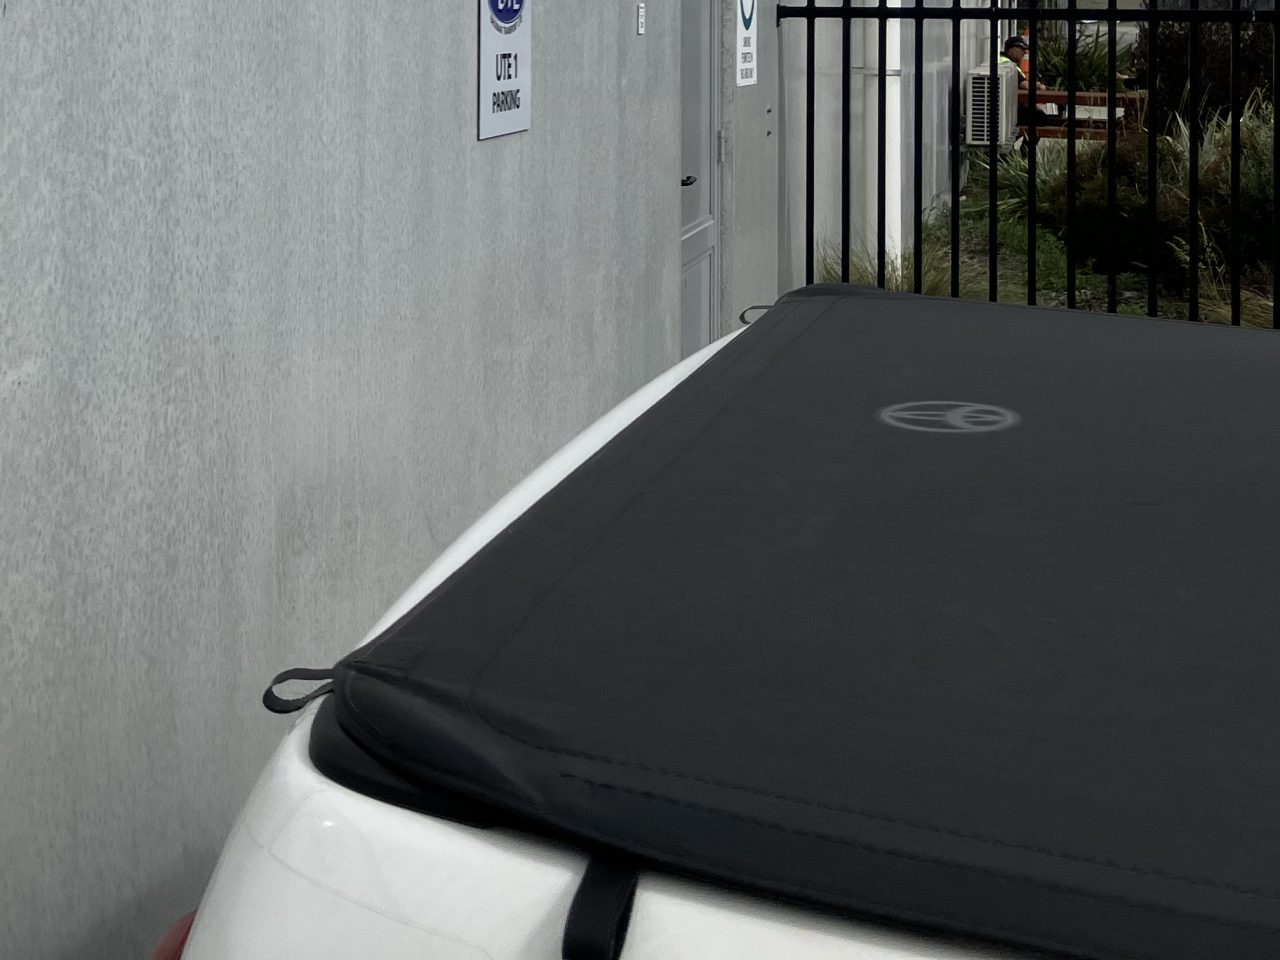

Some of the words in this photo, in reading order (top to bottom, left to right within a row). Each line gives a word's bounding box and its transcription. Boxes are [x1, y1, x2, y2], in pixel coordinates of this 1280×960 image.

[495, 52, 512, 82] UTE
[513, 52, 518, 80] 1
[491, 88, 521, 114] PARKING
